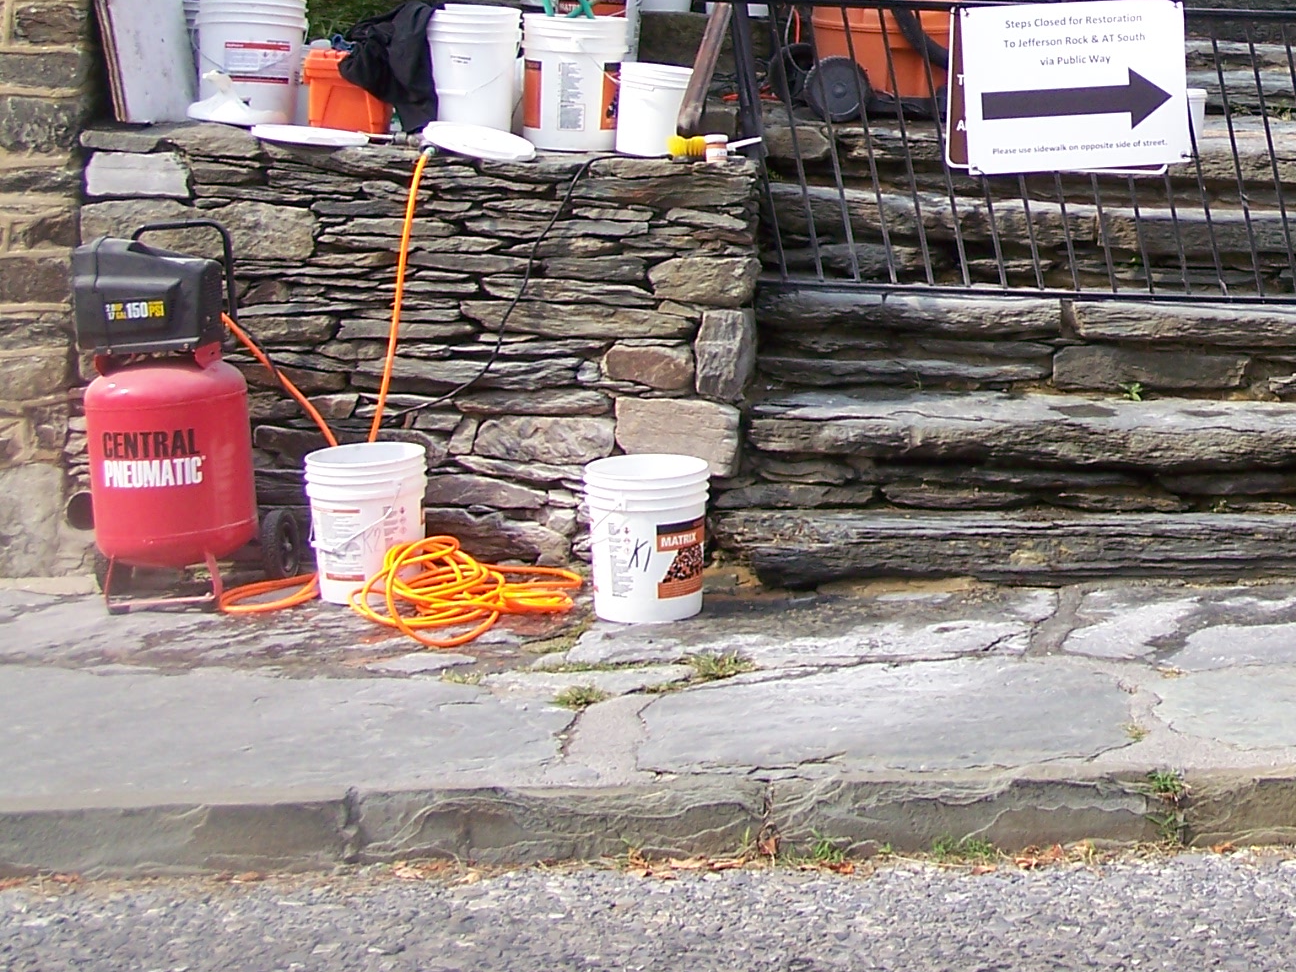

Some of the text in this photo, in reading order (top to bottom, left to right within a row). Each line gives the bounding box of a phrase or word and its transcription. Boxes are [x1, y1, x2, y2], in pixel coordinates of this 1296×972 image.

[1005, 13, 1143, 30] Steps Closed for Restoration
[1004, 32, 1146, 48] To Jefferson Rock & AT South
[1040, 54, 1111, 66] via Public Way
[992, 147, 1017, 155] Please
[1033, 143, 1067, 152] sidewalk
[1080, 141, 1114, 151] opposite
[1116, 140, 1131, 148] side
[1143, 139, 1168, 147] street.
[126, 301, 165, 318] 150 PSI
[103, 428, 200, 459] CENTRAL
[104, 456, 203, 488] PNEUMATIC
[661, 532, 698, 547] MATRIX
